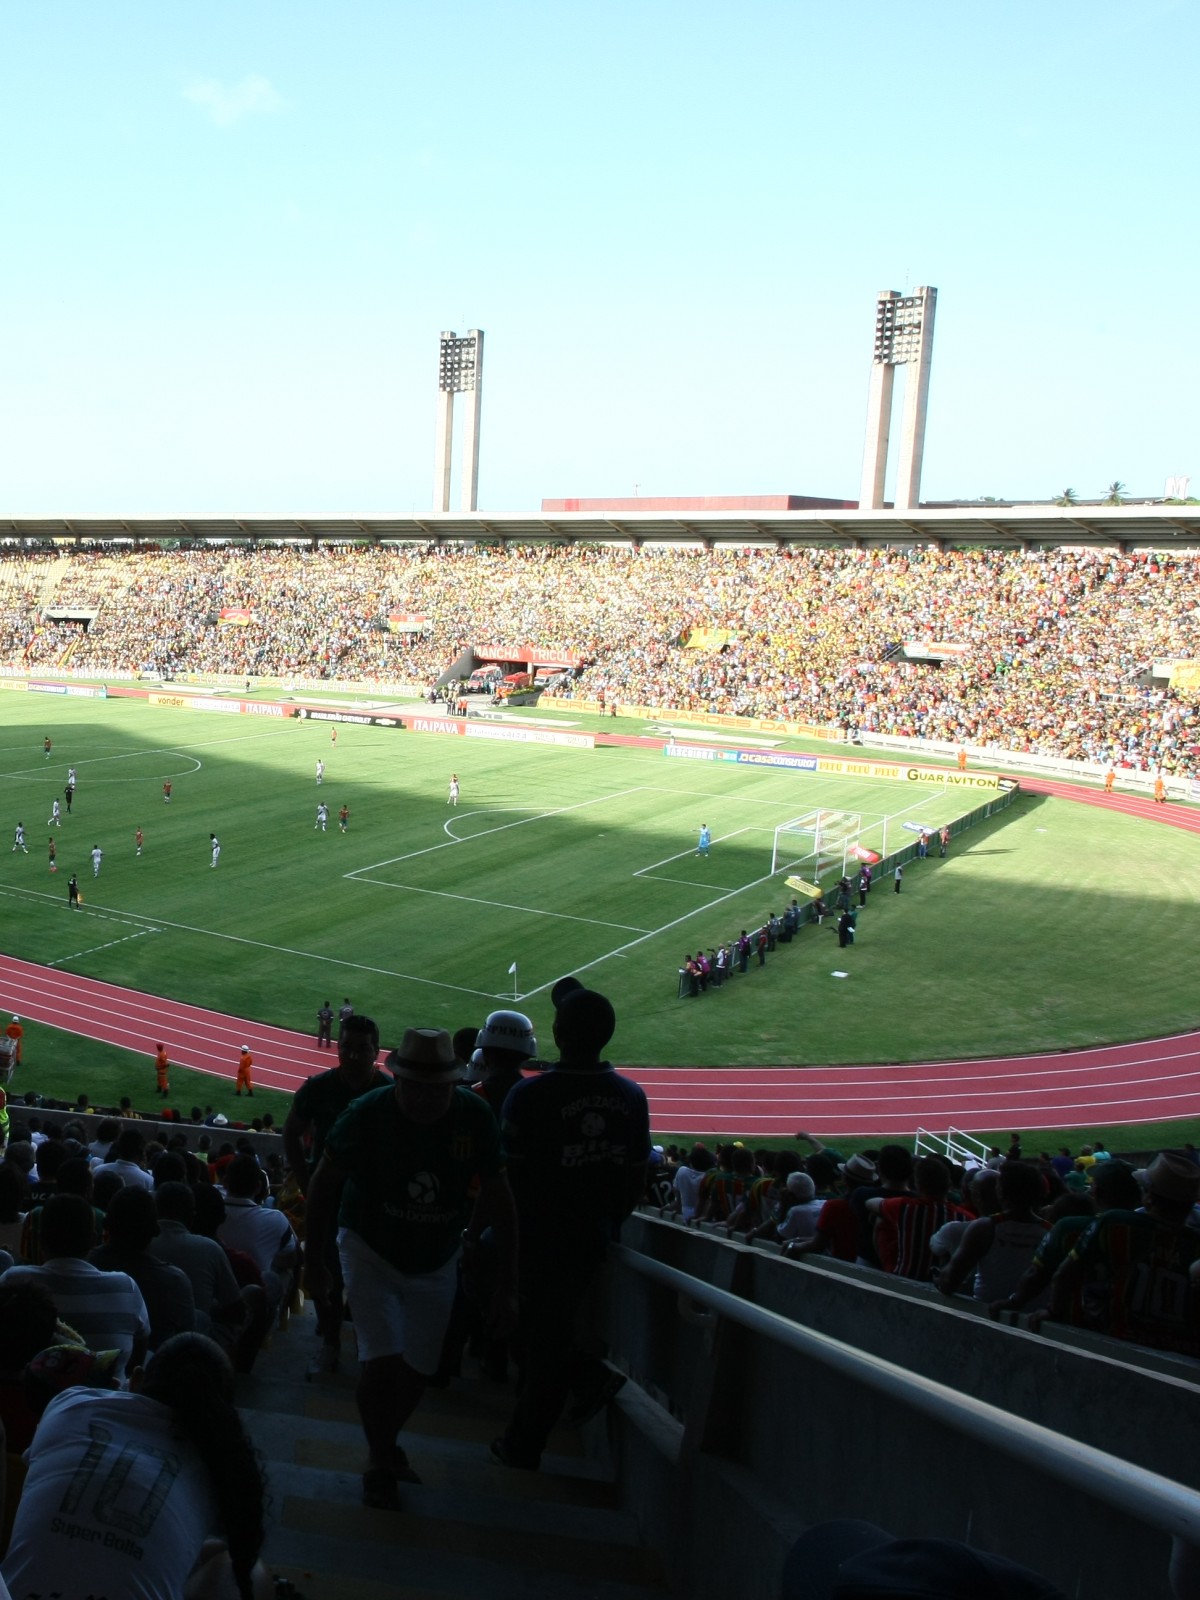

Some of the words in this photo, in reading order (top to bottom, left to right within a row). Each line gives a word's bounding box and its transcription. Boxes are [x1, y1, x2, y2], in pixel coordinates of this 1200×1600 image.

[157, 697, 184, 706] vonder
[245, 703, 283, 716] ITAIPAVA
[414, 719, 458, 734] ITAIPAVA
[760, 721, 788, 733] DA
[907, 769, 996, 788] GUARAVITON
[60, 1423, 179, 1538] 10
[51, 1517, 101, 1542] Super
